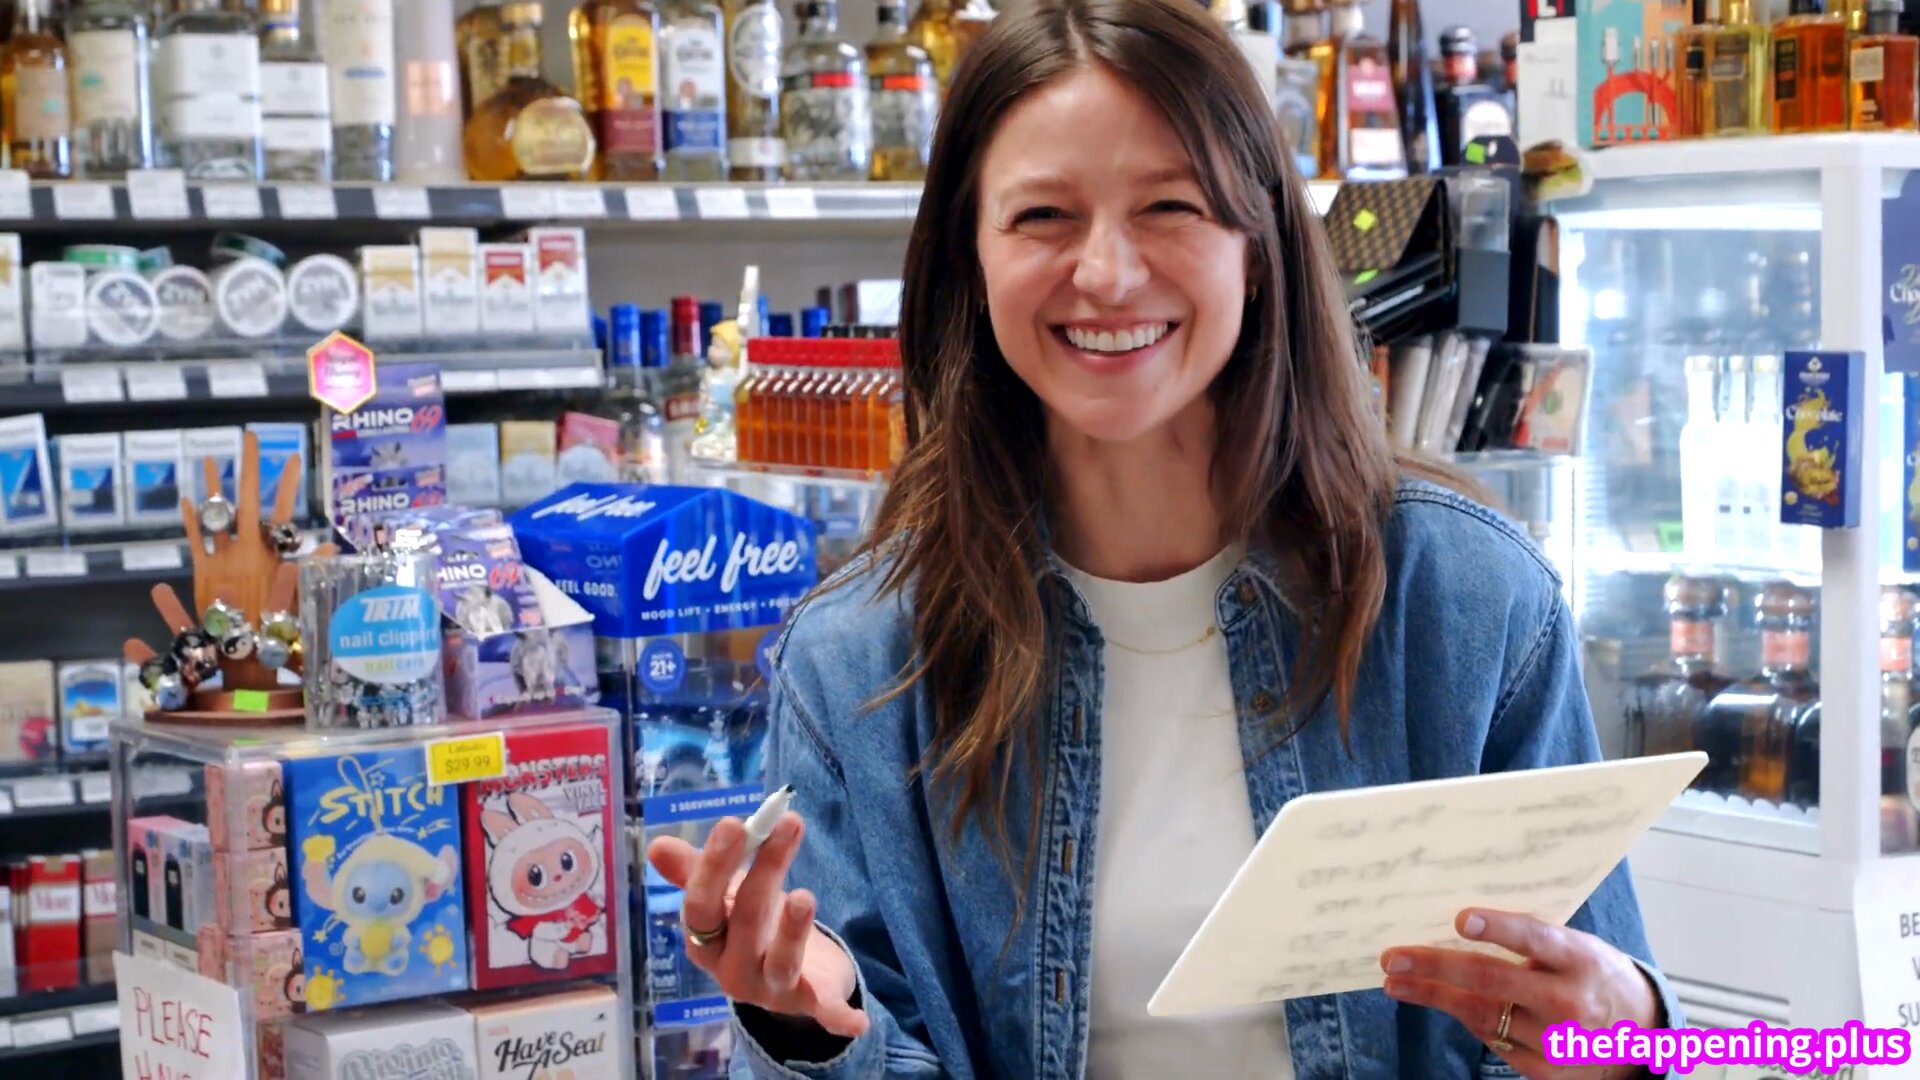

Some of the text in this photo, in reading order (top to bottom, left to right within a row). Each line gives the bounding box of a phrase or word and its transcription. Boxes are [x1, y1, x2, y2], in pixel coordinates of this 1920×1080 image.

[332, 407, 413, 432] RHINO
[411, 404, 443, 432] 69
[436, 563, 488, 583] HINO
[643, 534, 718, 601] feel
[359, 593, 421, 622] TRIM
[641, 608, 675, 621] MOOD
[339, 631, 374, 648] nail
[319, 782, 444, 824] STITCH
[132, 985, 214, 1060] PLEASE
